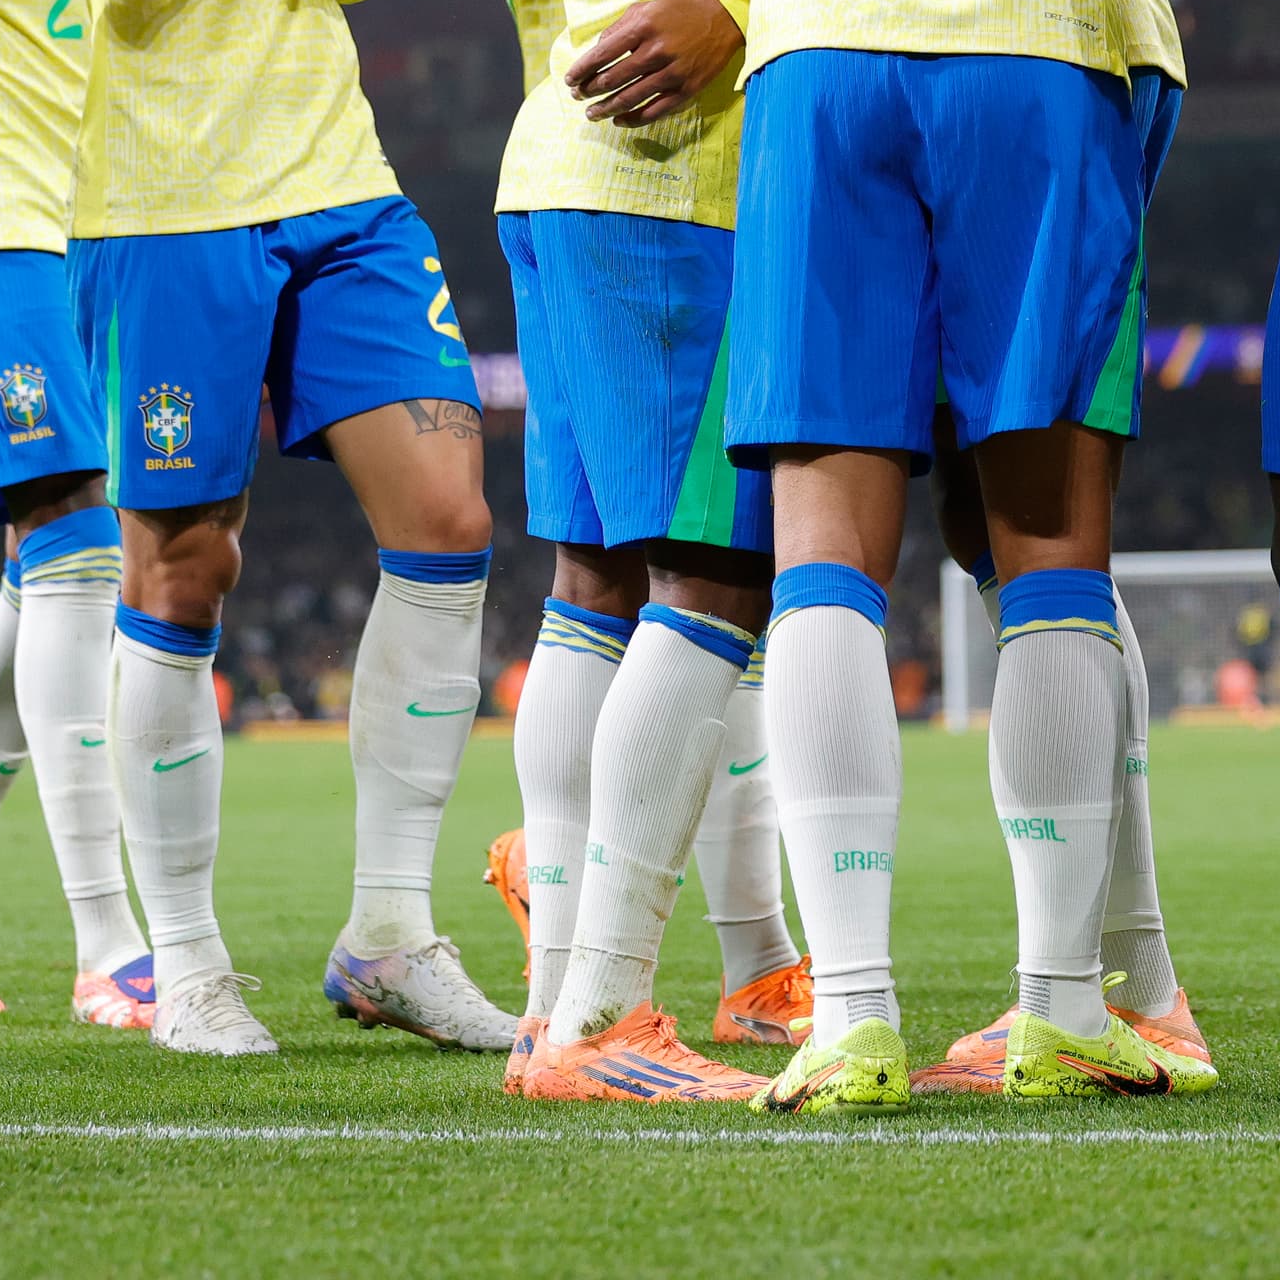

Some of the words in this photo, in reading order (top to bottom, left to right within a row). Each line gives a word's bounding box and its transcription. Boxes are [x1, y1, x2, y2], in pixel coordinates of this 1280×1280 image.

[157, 418, 176, 426] CBF
[9, 427, 56, 445] BRASIL
[145, 457, 196, 471] BRASIL
[587, 843, 608, 865] SIL
[528, 865, 568, 885] ASIL
